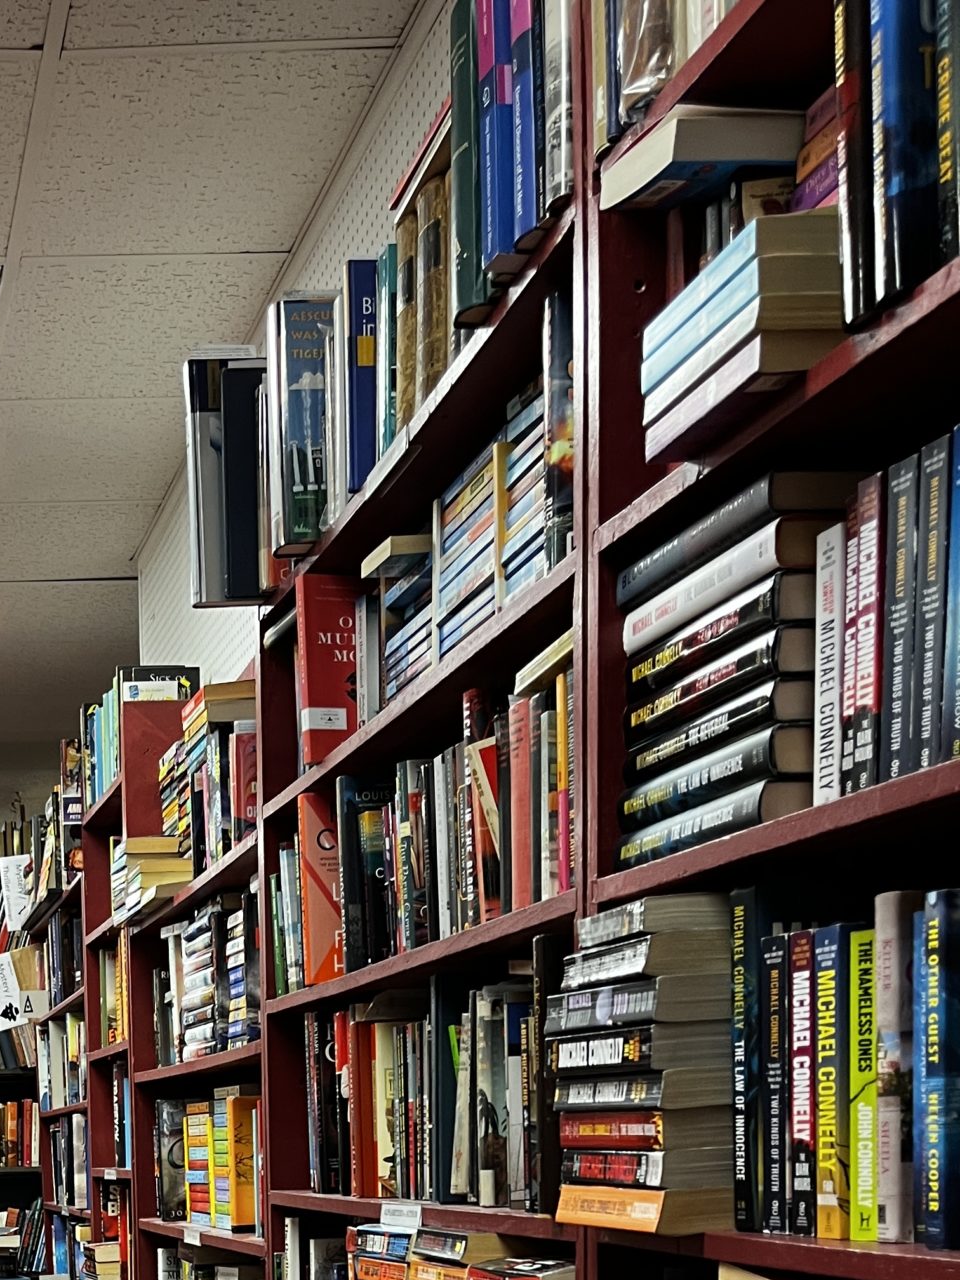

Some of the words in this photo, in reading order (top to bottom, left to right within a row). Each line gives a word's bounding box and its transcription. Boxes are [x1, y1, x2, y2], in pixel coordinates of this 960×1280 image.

[936, 55, 953, 130] CRIME
[937, 130, 954, 184] BEAT
[290, 329, 321, 341] WAS
[895, 496, 908, 547] MICHAEL
[928, 476, 941, 526] MICHAEL
[860, 519, 878, 611] MICHAEL
[894, 549, 907, 598] CONNELLY
[927, 530, 939, 581] CONNELLY
[819, 618, 836, 697] MICHAEL
[858, 611, 876, 706] CONNELLY
[892, 639, 904, 663] TWO
[924, 623, 935, 648] TWO
[892, 665, 903, 697] KINDS
[923, 651, 935, 684] KINDS
[891, 701, 902, 713] OF
[921, 705, 933, 739] TRUTH
[819, 702, 836, 791] CONNELLY
[890, 718, 902, 750] TRUTH
[3, 866, 11, 890] Thriller
[16, 864, 25, 894] Mystery
[734, 905, 745, 961] MICHAEL
[857, 940, 873, 968] THE
[927, 918, 940, 949] THE
[733, 966, 745, 1029] CONNELLY
[771, 969, 779, 1015] MICHAEL
[857, 968, 872, 1037] NAMELESS
[927, 954, 940, 1008] OTHER
[793, 970, 810, 1050] MICHAEL
[817, 969, 836, 1063] MICHAEL
[734, 1040, 745, 1057] THE
[771, 1017, 779, 1068] CONNELLY
[857, 1039, 873, 1073] ONES
[927, 1012, 940, 1063] GUEST
[734, 1066, 745, 1092] LAW
[734, 1095, 745, 1111] OF
[771, 1095, 779, 1111] TWO
[793, 1054, 810, 1141] CONNELLY
[771, 1115, 779, 1139] KINDS
[817, 1066, 836, 1172] CONNELLY
[857, 1102, 872, 1139] JOHN
[927, 1093, 940, 1143] HELEN
[734, 1114, 745, 1181] INNOCENCE
[771, 1143, 779, 1155] OF
[771, 1156, 779, 1192] TRUTH
[856, 1141, 872, 1208] CONNOLLY
[927, 1147, 940, 1212] COOPER
